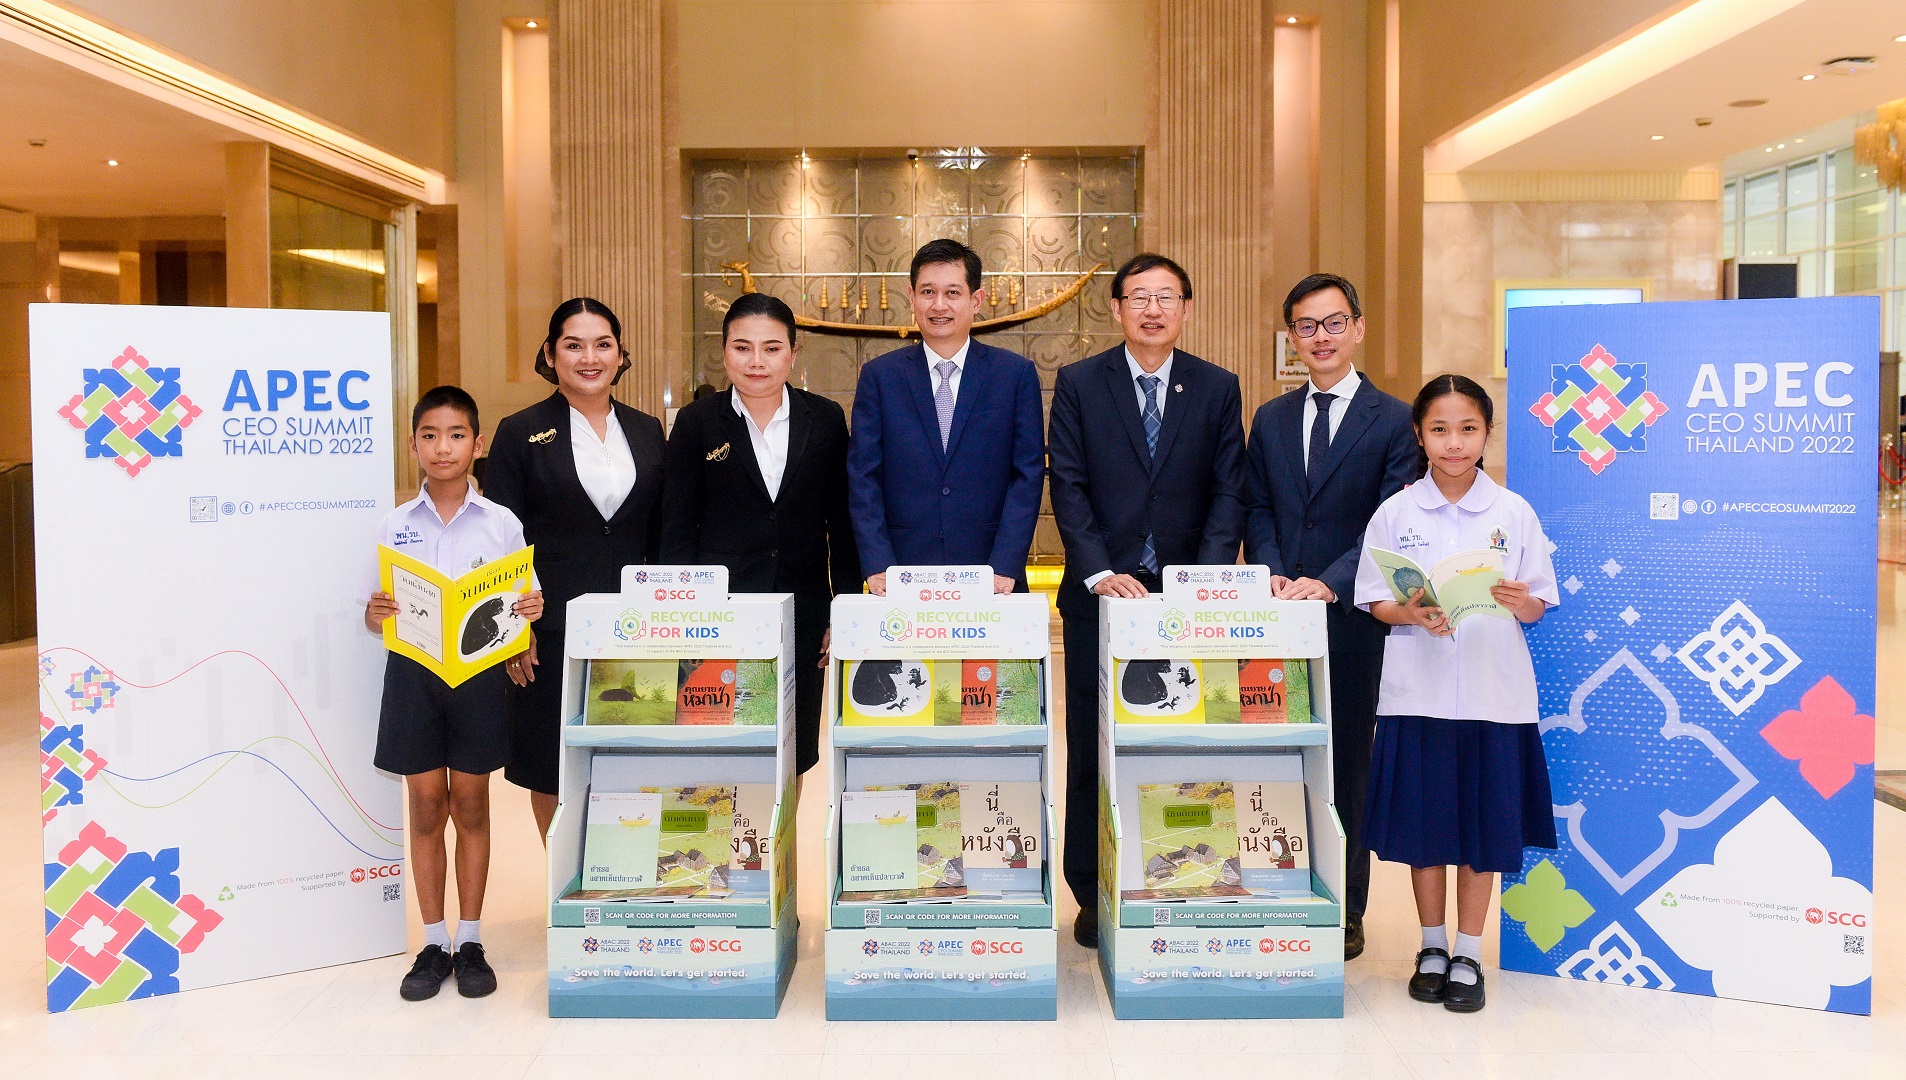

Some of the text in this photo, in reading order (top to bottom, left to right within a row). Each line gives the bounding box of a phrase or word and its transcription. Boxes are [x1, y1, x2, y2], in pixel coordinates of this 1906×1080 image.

[222, 370, 371, 412] APEC
[1686, 362, 1855, 408] APEC
[223, 416, 373, 437] CEO SUMMIT
[1686, 412, 1855, 433] CEO SUMMIT
[223, 438, 373, 455] THAILAND 2022
[1686, 436, 1855, 453] THAILAND 2022
[260, 499, 376, 512] #APECCEOSUMMIT2022
[1722, 502, 1856, 514] #APECCEOSUMMIT2022
[670, 590, 695, 599] SCG
[935, 591, 961, 600] SCG
[1212, 590, 1238, 599] SCG
[651, 612, 734, 622] RECYCLING
[917, 612, 1000, 622] RECYCLING
[1194, 611, 1279, 622] RECYCLING
[651, 627, 719, 638] FOR KIDS
[917, 627, 986, 638] FOR KIDS
[1195, 627, 1264, 638] FOR KIDS
[986, 785, 998, 811] นี่
[1250, 785, 1262, 812] นี่
[734, 814, 749, 827] คือ
[997, 812, 1013, 825] คือ
[1262, 812, 1277, 825] คือ
[369, 864, 400, 879] SCG
[258, 880, 274, 888] from
[296, 873, 323, 883] recycled
[325, 870, 346, 881] paper.
[301, 881, 336, 892] Supported
[1744, 901, 1774, 910] recycled
[1749, 911, 1800, 923] Supported by
[1828, 912, 1866, 927] SCG
[709, 940, 741, 952] SCG
[990, 942, 1023, 953] SCG
[1226, 939, 1251, 947] APEC
[1278, 940, 1310, 952] SCG
[575, 968, 748, 979] Save the world. Let's get started.
[855, 970, 1029, 981] Save the world. Let's get started.
[1143, 969, 1316, 980] Save the world. Let's get started.
